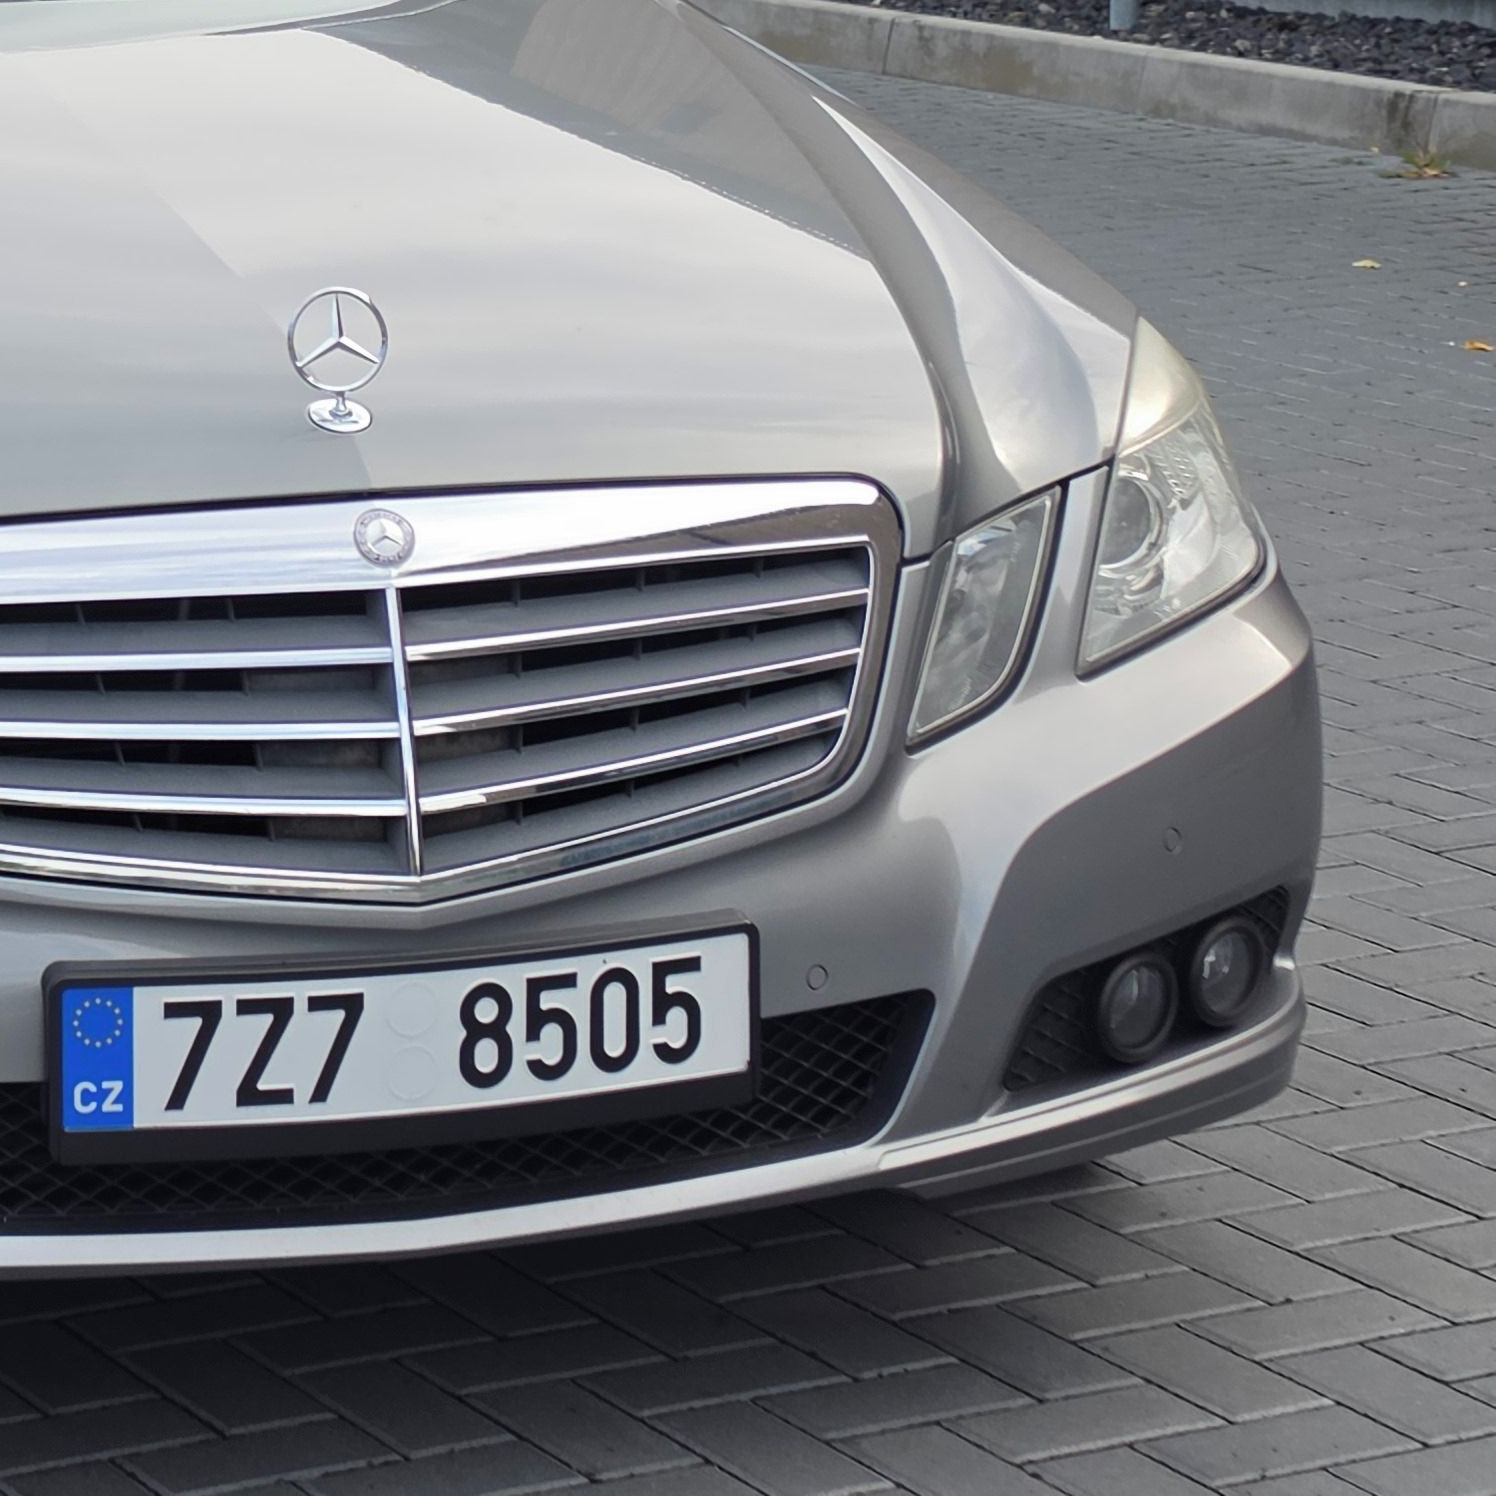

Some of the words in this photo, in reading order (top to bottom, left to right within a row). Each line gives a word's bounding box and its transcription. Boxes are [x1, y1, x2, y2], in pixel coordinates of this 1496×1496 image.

[163, 991, 365, 1112] 7Z7
[458, 954, 703, 1090] 8505
[72, 1080, 124, 1115] CZ
